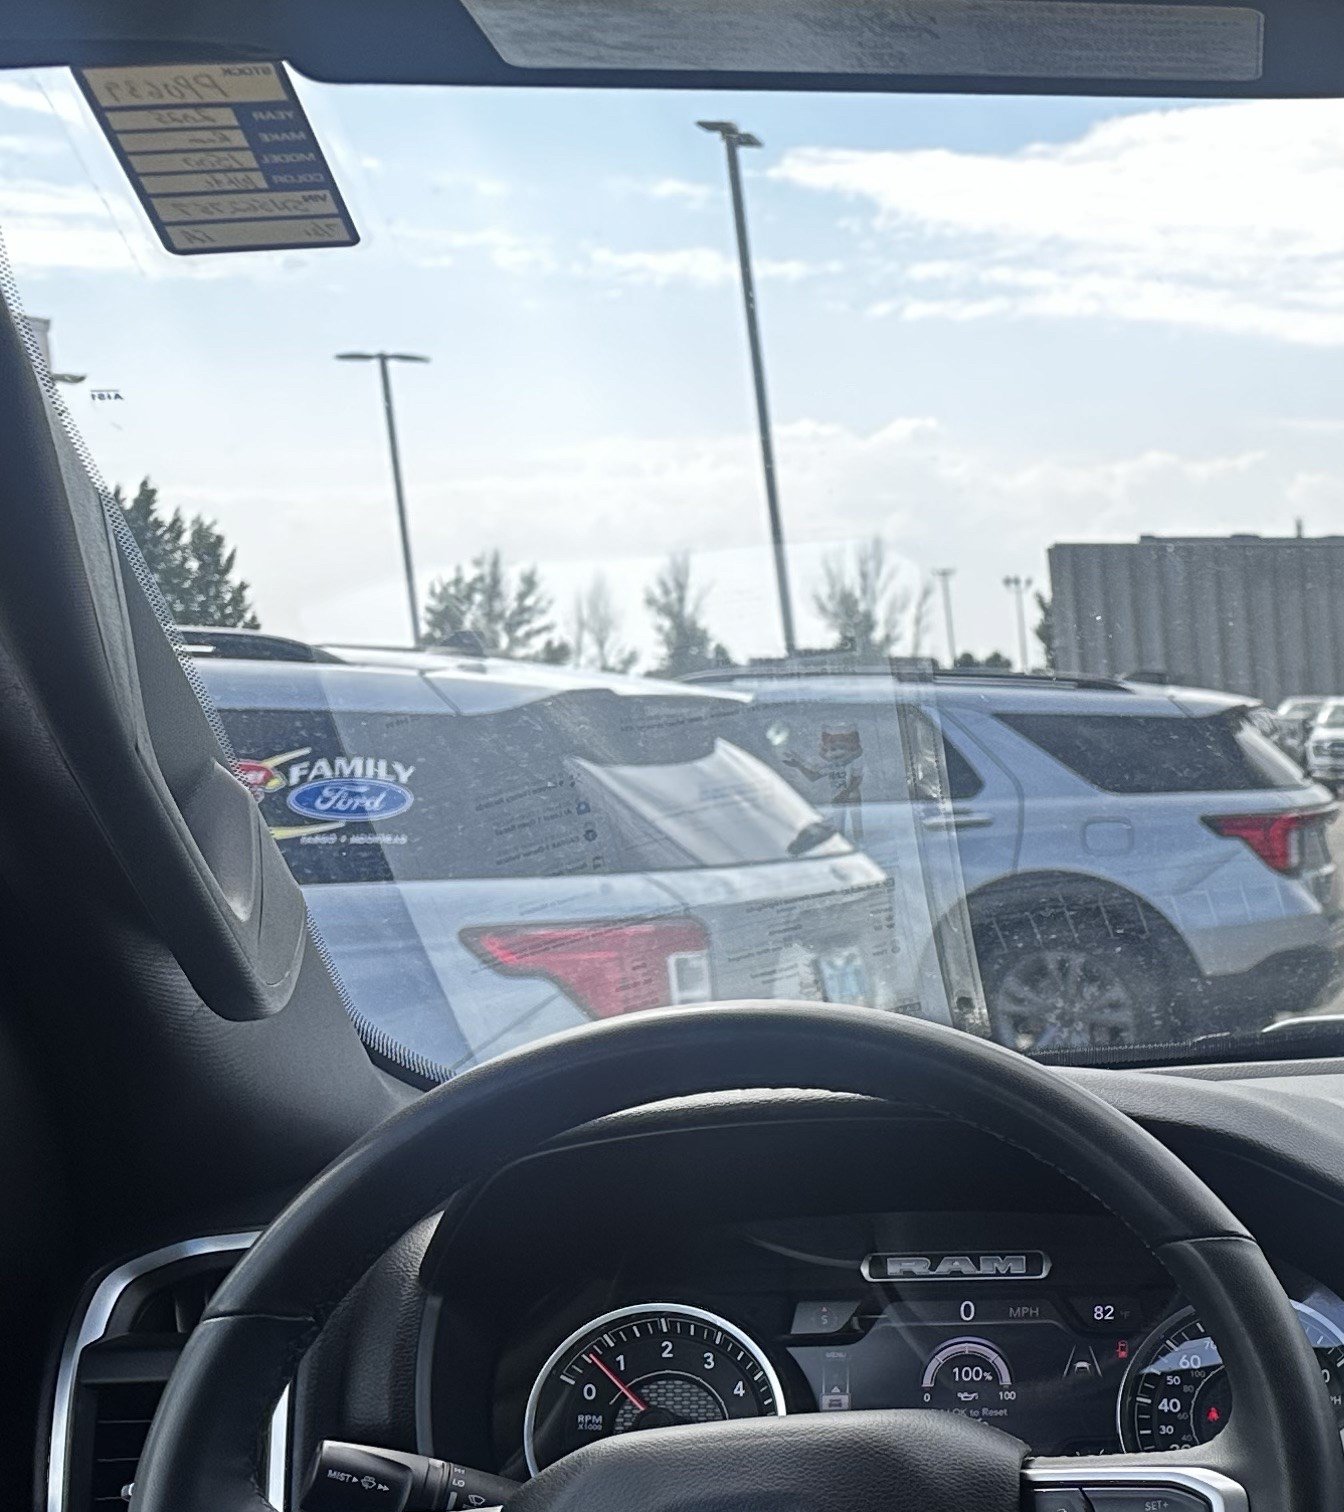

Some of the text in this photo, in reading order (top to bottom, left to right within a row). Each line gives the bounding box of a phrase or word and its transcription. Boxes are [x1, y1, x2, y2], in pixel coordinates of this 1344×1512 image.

[288, 757, 416, 786] FAMILY
[315, 786, 386, 811] Ford
[886, 1255, 1027, 1276] RAM
[959, 1300, 1040, 1322] 0 MPH
[1093, 1305, 1115, 1321] 82
[661, 1341, 674, 1358] 2
[615, 1354, 626, 1371] 1
[703, 1353, 715, 1370] 3
[1179, 1355, 1201, 1369] 60
[952, 1366, 993, 1382] 100%
[1166, 1375, 1181, 1386] 50
[582, 1384, 597, 1400] 0
[733, 1381, 746, 1397] 4
[998, 1391, 1016, 1401] 100
[1158, 1398, 1181, 1413] 40
[577, 1414, 603, 1423] RPM
[1159, 1425, 1174, 1435] 30
[328, 1469, 351, 1483] MIST
[452, 1479, 466, 1488] LO
